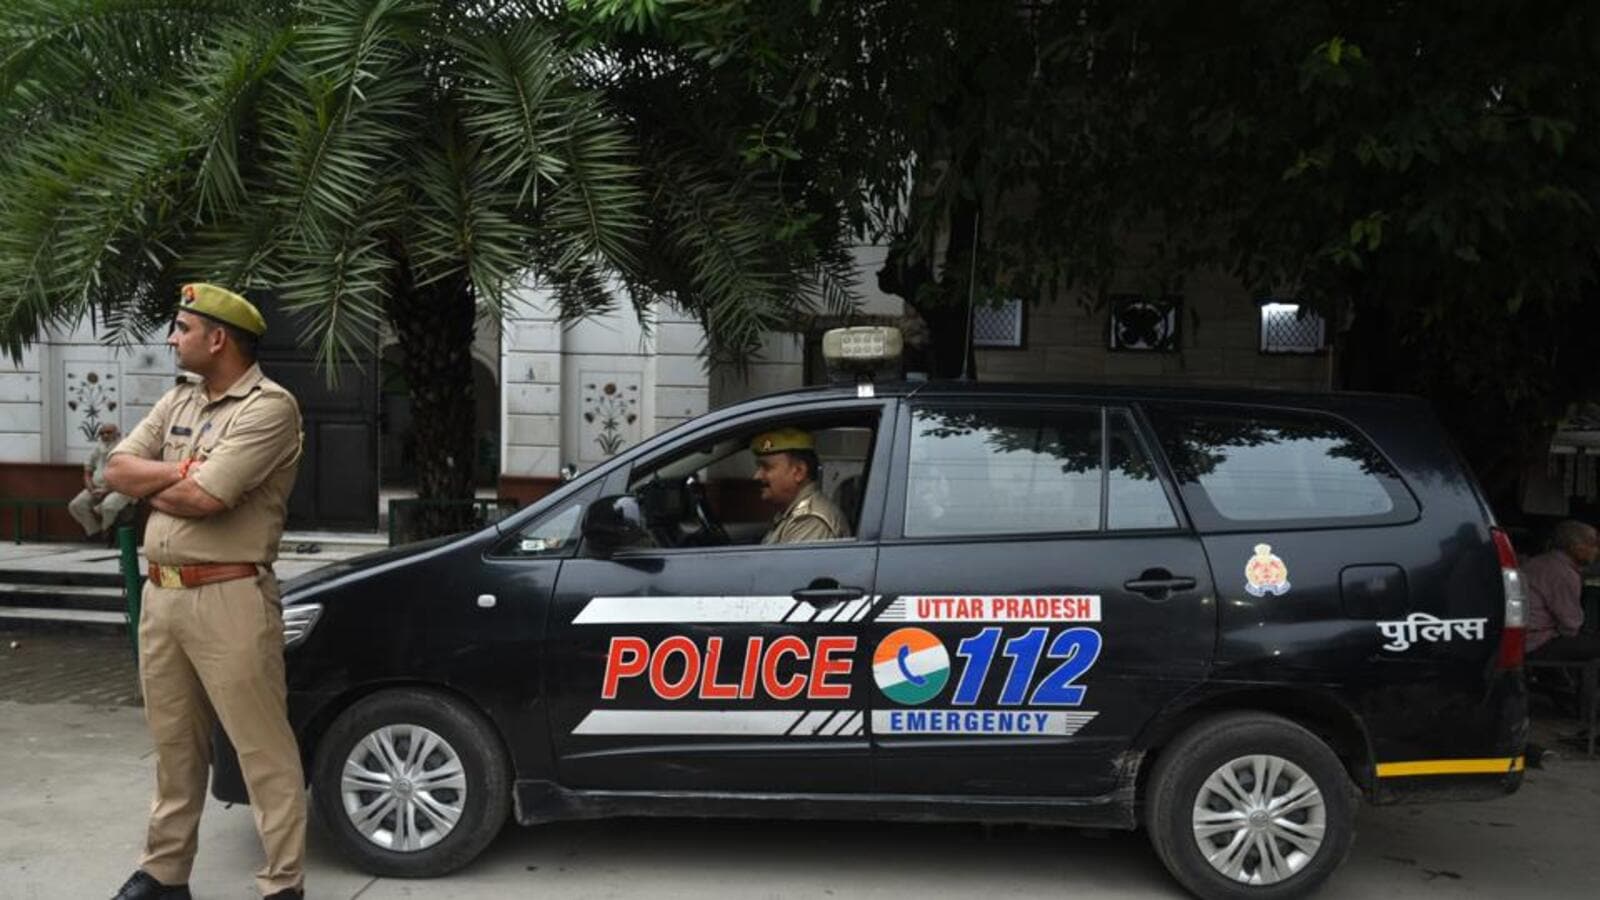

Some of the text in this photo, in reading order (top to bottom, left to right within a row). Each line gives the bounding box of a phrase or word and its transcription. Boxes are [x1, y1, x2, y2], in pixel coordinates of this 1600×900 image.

[917, 597, 1091, 619] UTTAR PRADESH
[1376, 612, 1488, 651] पुलिस
[601, 635, 857, 700] POLICE
[951, 626, 1103, 706] 112
[890, 712, 1049, 732] EMERGENCY
